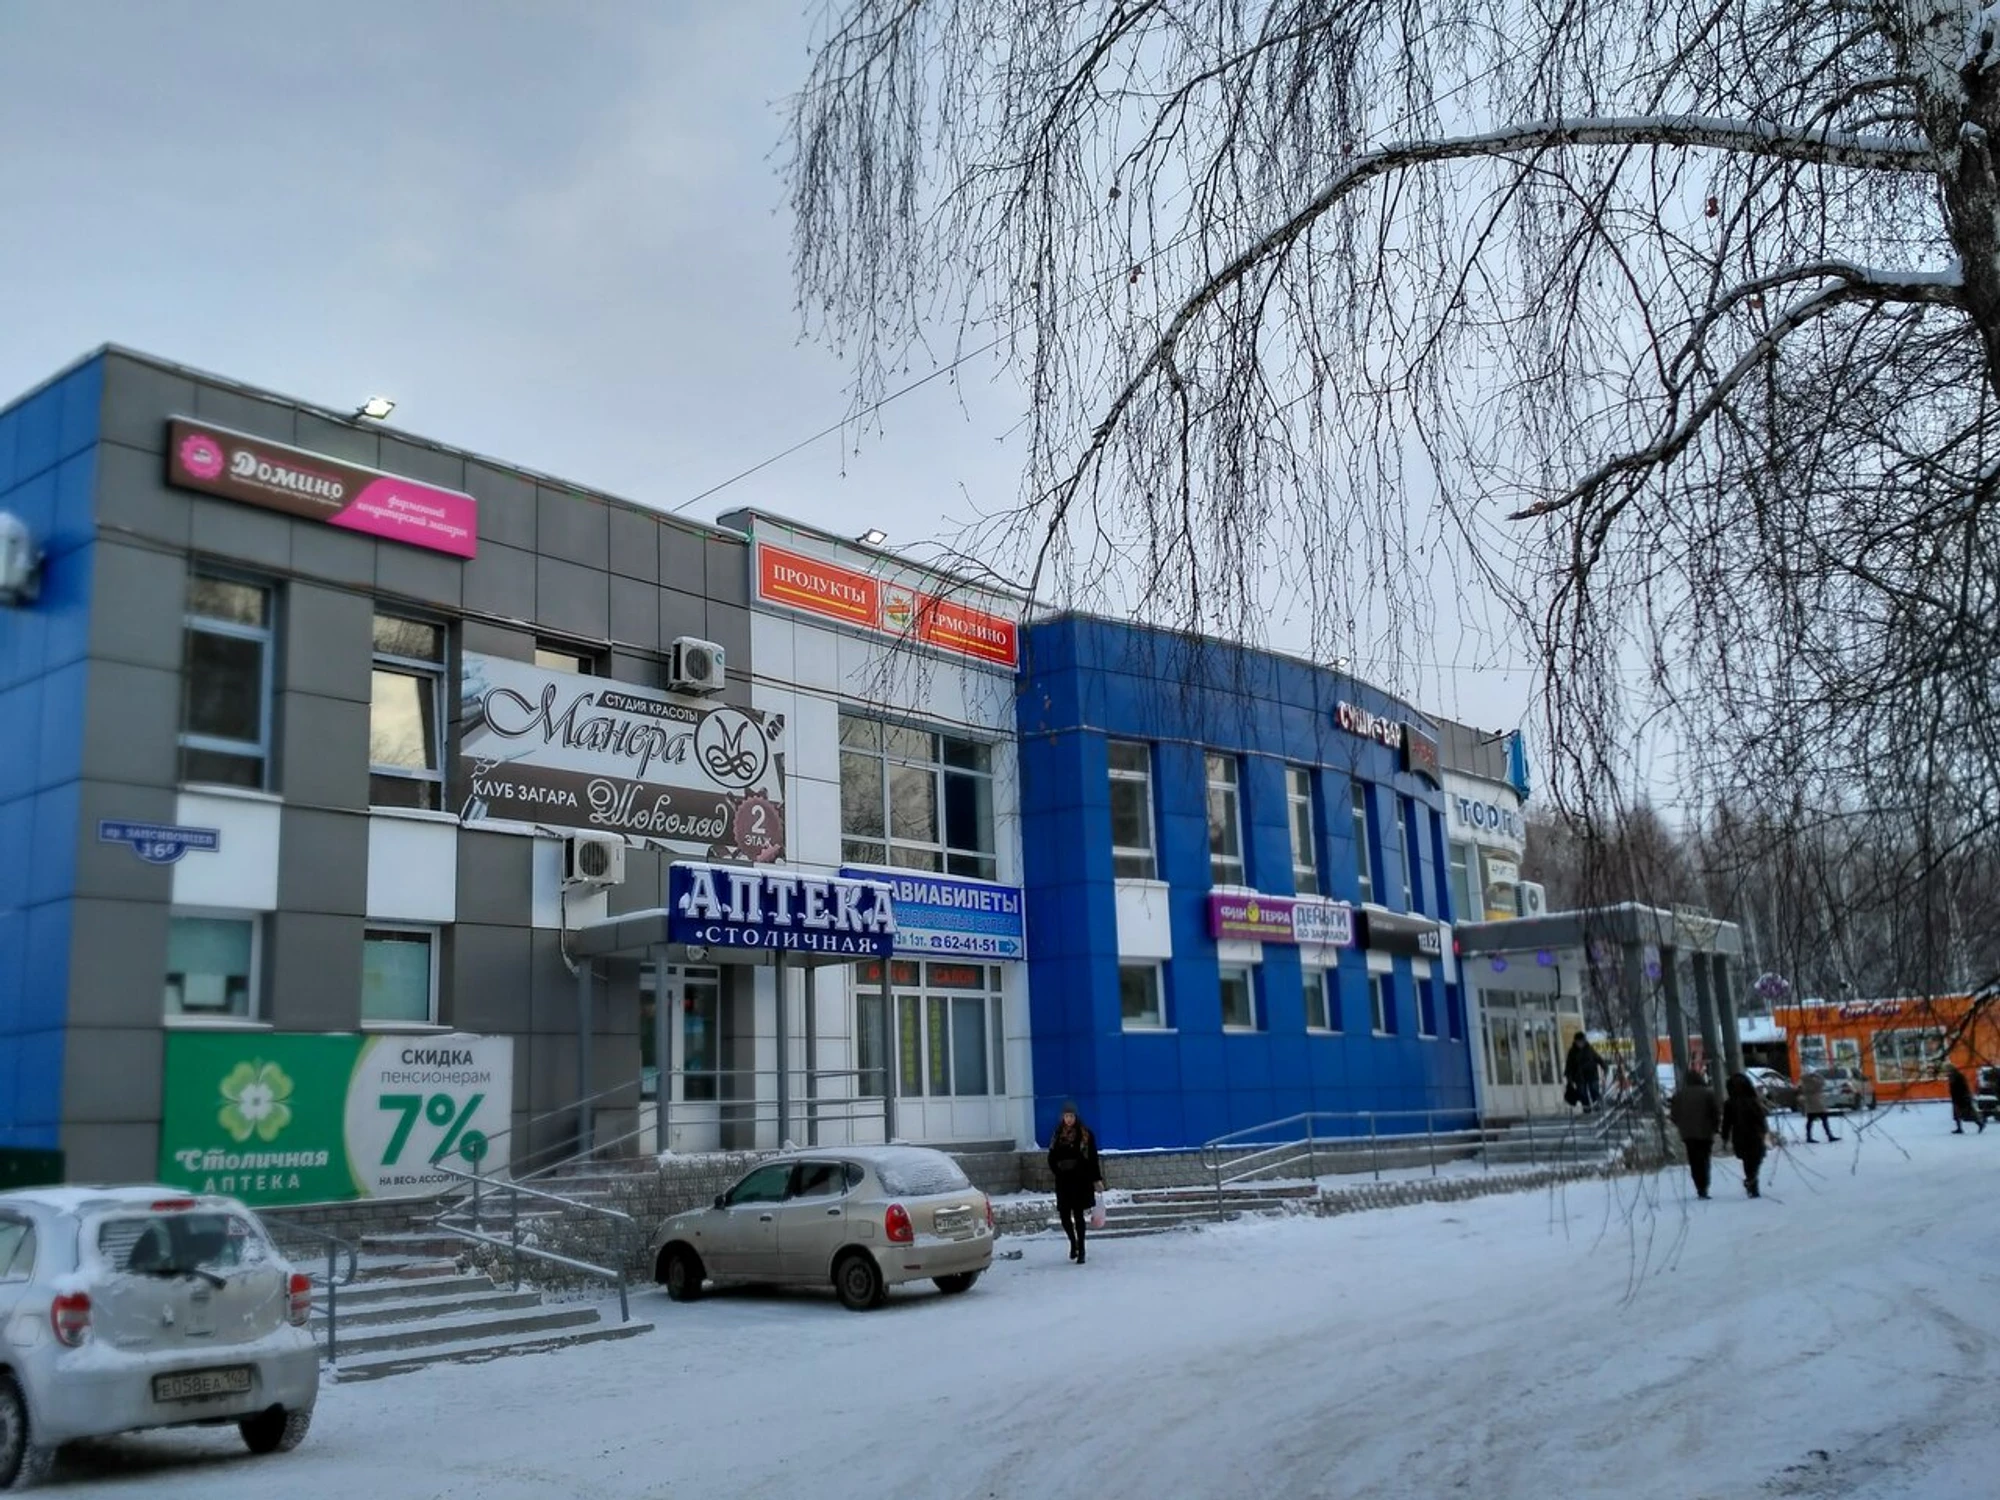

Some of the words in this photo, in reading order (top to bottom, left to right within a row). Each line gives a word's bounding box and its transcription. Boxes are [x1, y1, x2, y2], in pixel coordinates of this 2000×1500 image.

[229, 451, 344, 499] Домино
[773, 563, 867, 605] ПРОДУКТЫ
[604, 693, 647, 713] СТУДИЯ
[649, 701, 699, 722] КРАСОТЫ
[483, 682, 694, 779] Манера
[473, 779, 515, 799] КЛУБ
[517, 785, 578, 807] ЗАГАРА
[587, 777, 730, 839] Шоколад
[751, 804, 766, 834] 2
[744, 834, 773, 848] ЭТАЖ
[687, 866, 898, 934] АПТЕКА
[891, 880, 1018, 913] АВИАБИЛЕТЫ
[705, 926, 870, 953] СТОЛИЧНАЯ
[944, 935, 996, 952] 62-41-51
[401, 1049, 473, 1067] СКИДКА
[381, 1070, 491, 1085] пенсионерам
[379, 1093, 489, 1166] 7%
[175, 1149, 330, 1172] Столичная
[204, 1173, 300, 1193] АПТЕКА
[379, 1176, 392, 1186] НА
[393, 1175, 417, 1185] ВЕСЬ
